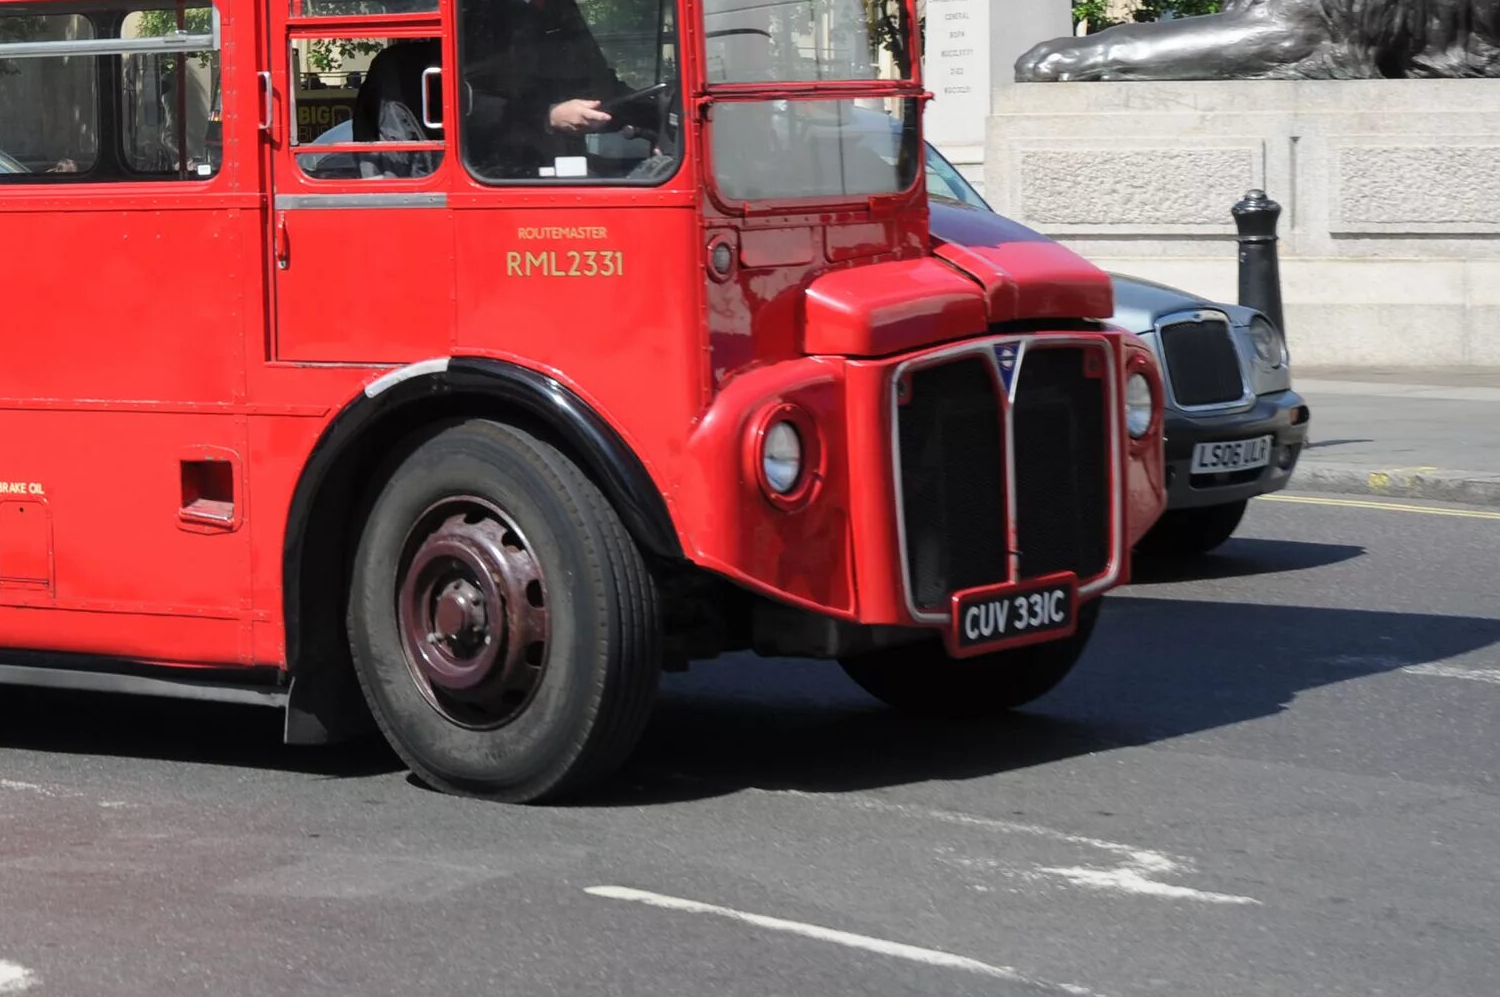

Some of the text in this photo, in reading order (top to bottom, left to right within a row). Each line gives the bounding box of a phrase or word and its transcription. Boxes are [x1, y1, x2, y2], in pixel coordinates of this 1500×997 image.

[298, 105, 331, 125] BIG
[517, 226, 608, 240] ROUTEMASTER
[506, 250, 624, 277] RML2331
[28, 482, 45, 495] OIL
[965, 589, 1065, 640] CUV 331C
